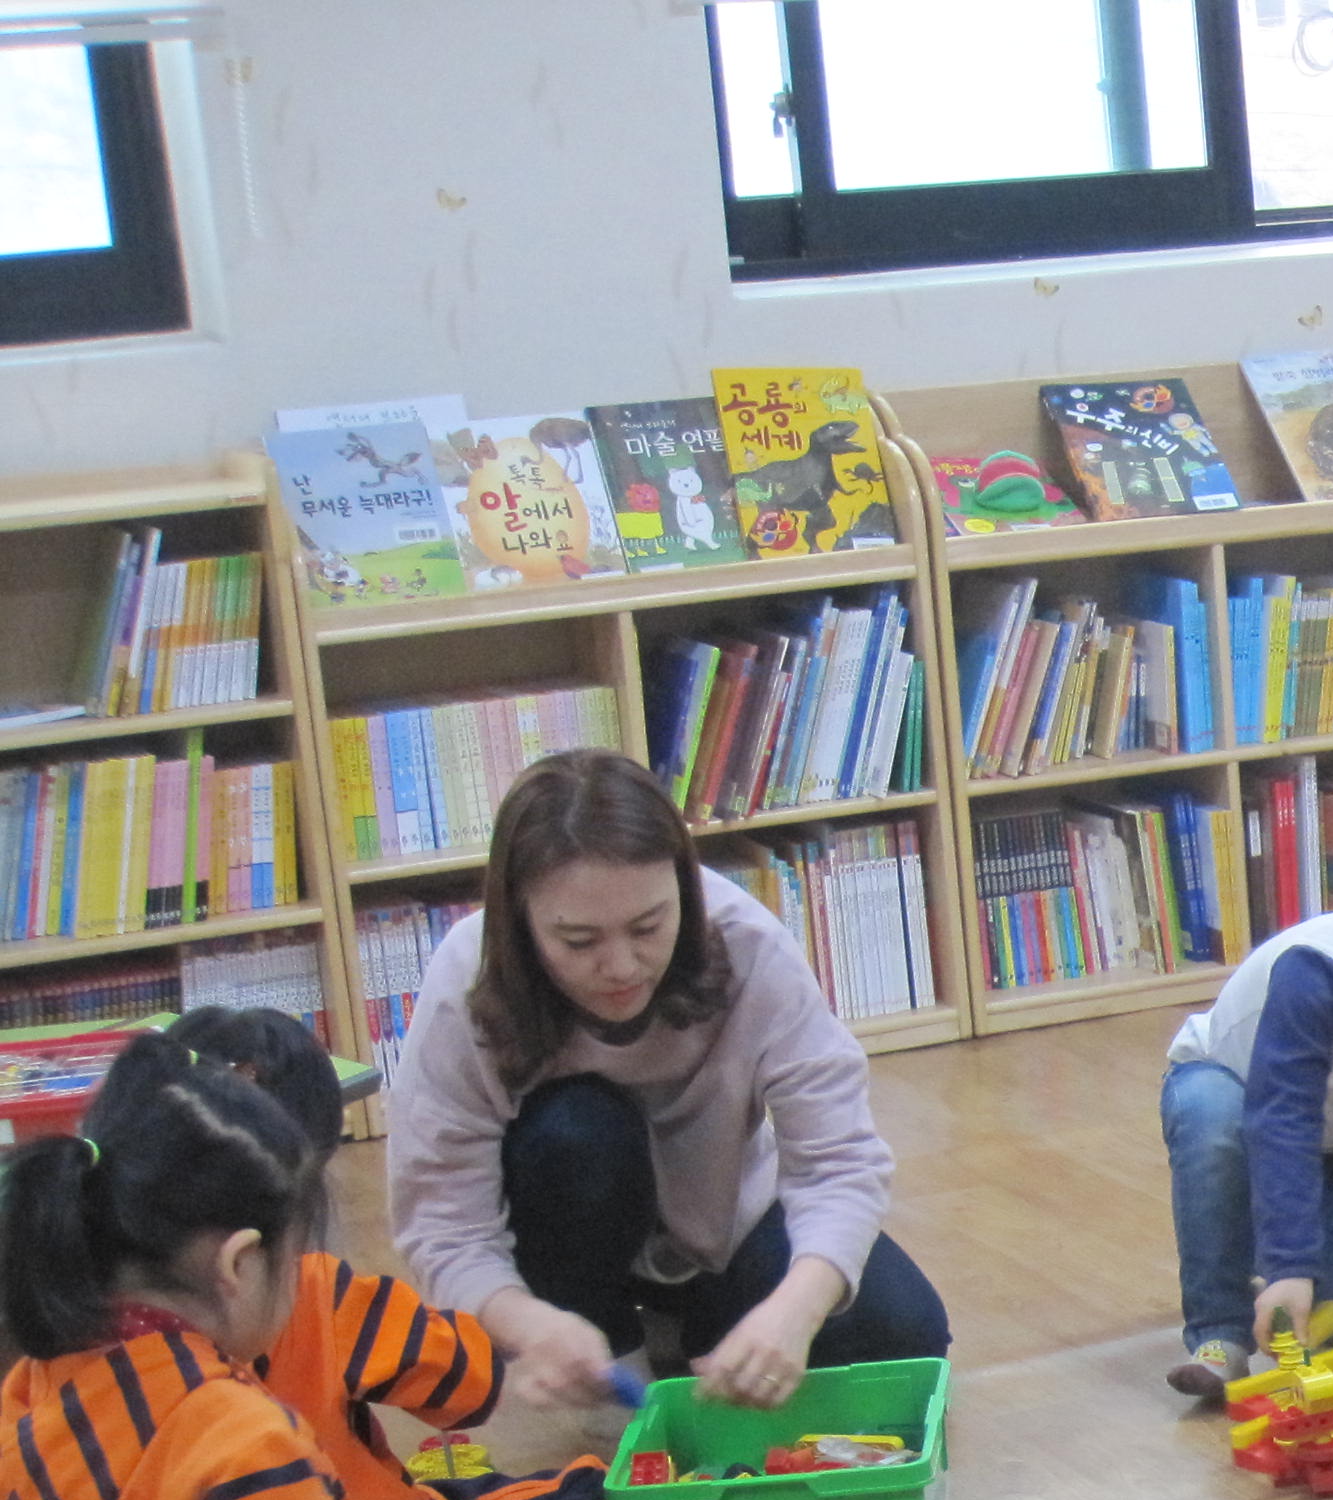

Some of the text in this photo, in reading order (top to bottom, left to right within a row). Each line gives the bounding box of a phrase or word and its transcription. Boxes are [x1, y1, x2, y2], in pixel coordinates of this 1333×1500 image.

[722, 382, 807, 428] 공룡의
[624, 433, 677, 458] 마술
[741, 426, 803, 451] 세계
[1139, 428, 1180, 455] 신비
[292, 474, 312, 495] 난
[302, 490, 434, 518] 무서운 늑대라구!
[480, 482, 574, 532] 알에서
[502, 528, 574, 555] 나와요
